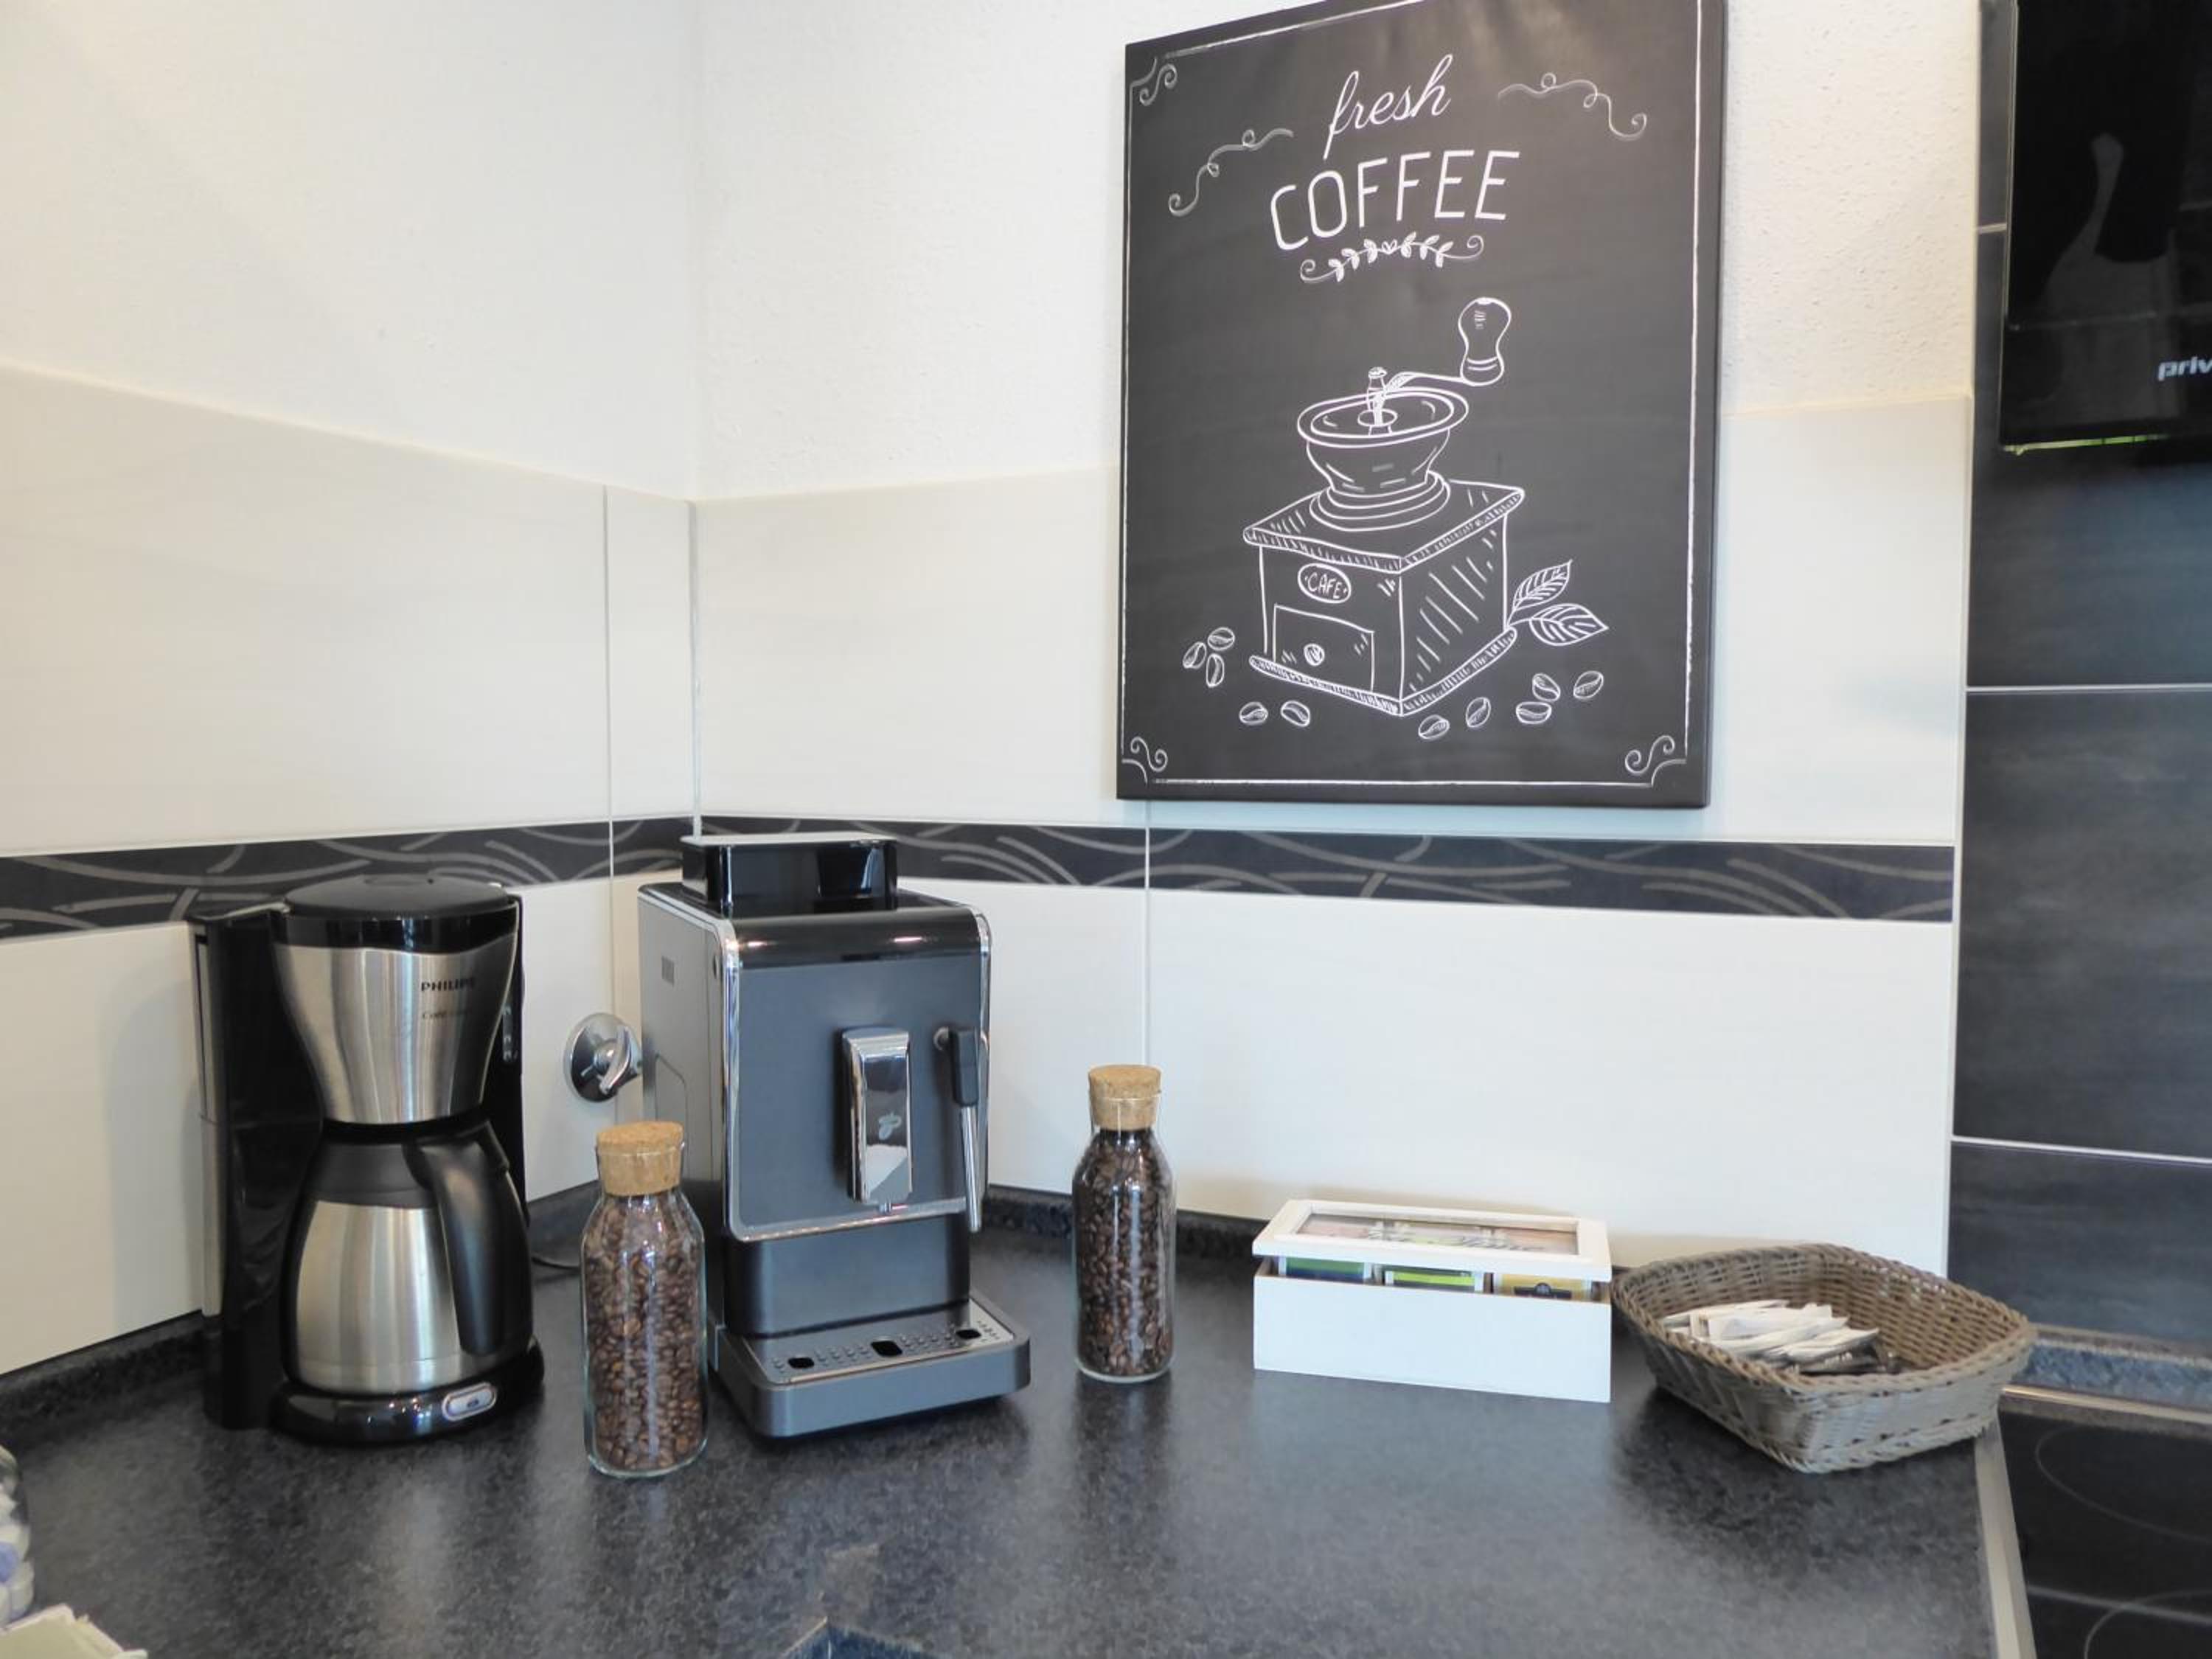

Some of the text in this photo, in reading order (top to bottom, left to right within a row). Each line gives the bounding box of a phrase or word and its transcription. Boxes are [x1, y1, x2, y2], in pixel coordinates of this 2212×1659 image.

[1324, 54, 1453, 160] fresh
[1270, 150, 1520, 251] COFFEE
[1307, 572, 1342, 599] CAFE
